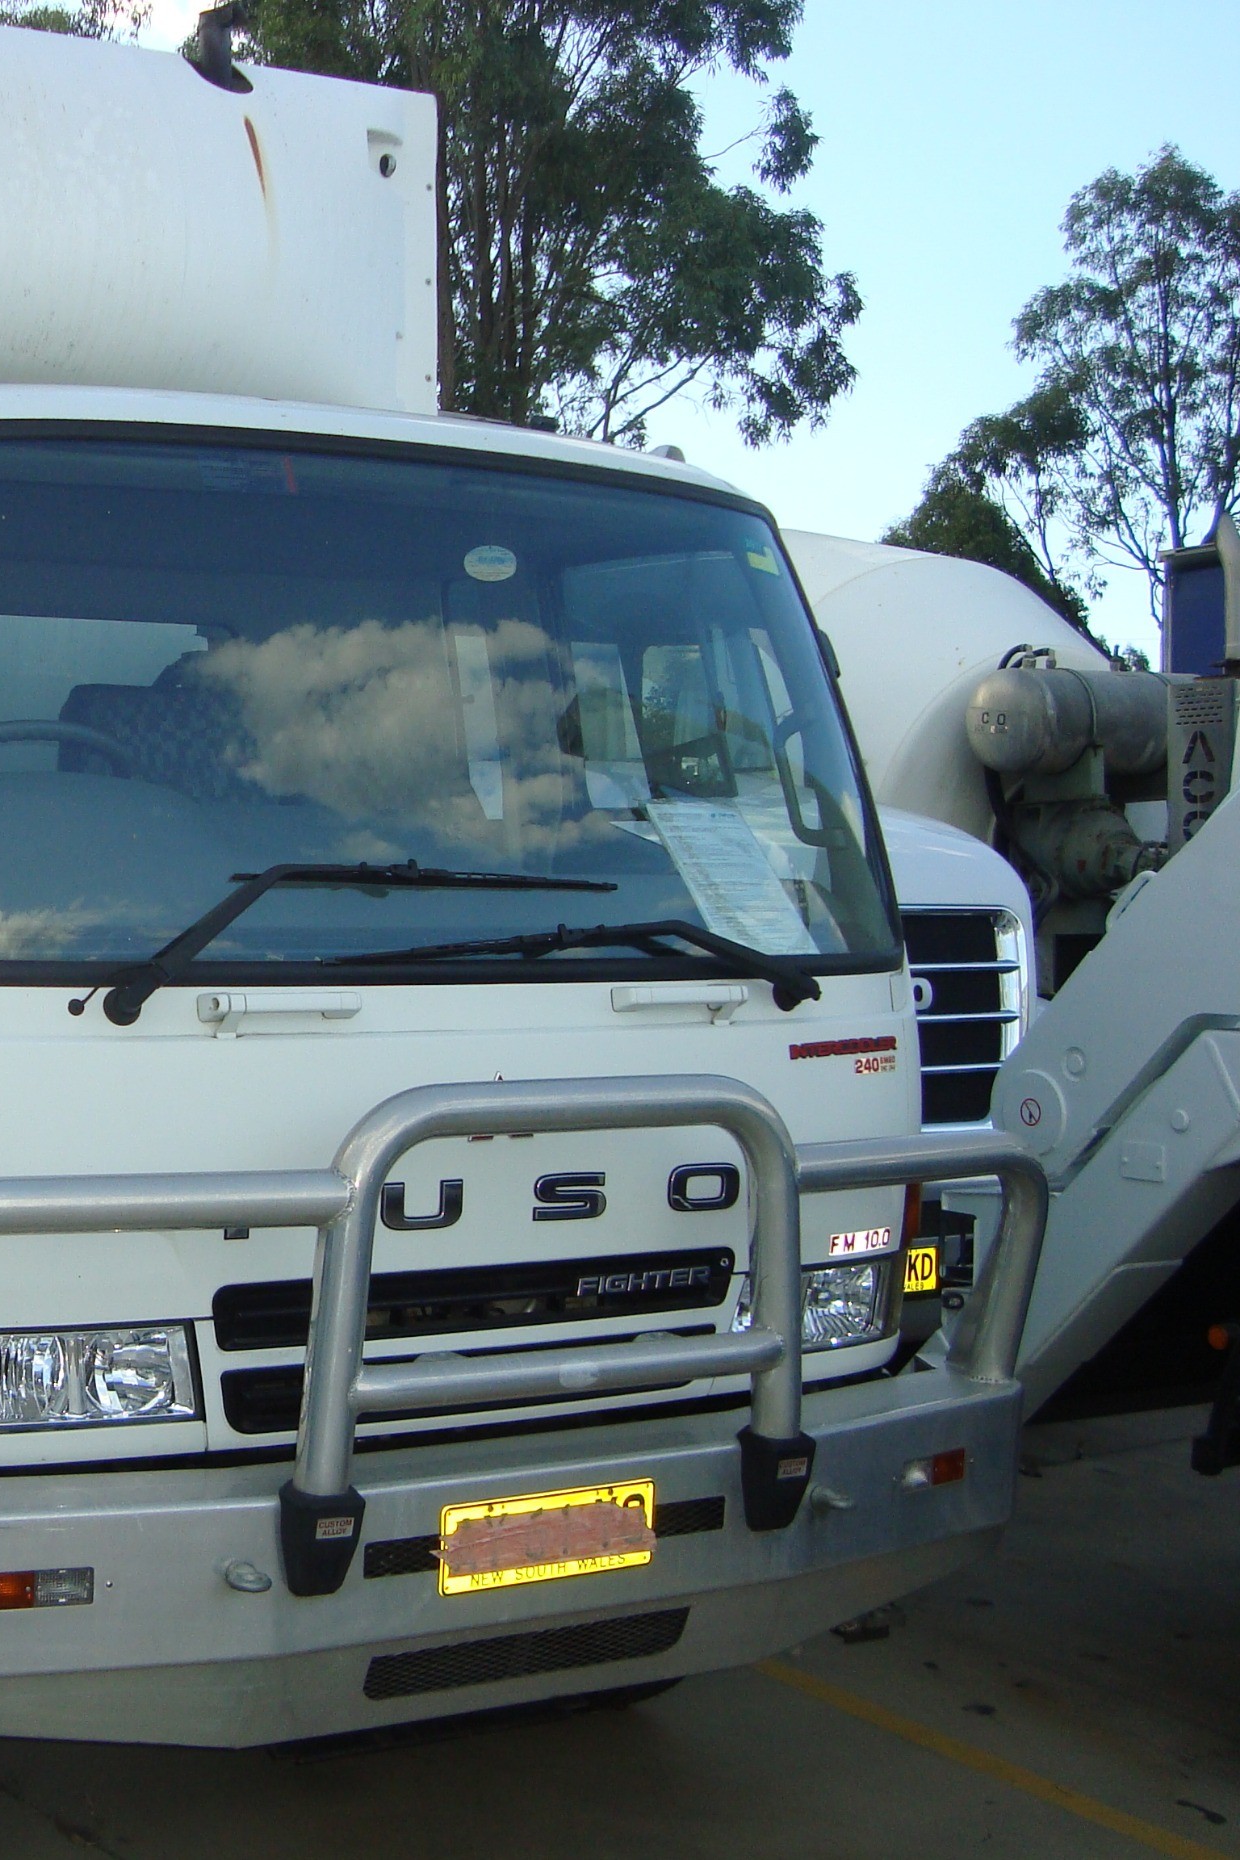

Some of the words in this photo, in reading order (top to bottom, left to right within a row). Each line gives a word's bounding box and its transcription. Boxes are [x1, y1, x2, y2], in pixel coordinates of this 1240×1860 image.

[789, 1035, 897, 1060] INTERCOOLER
[855, 1057, 879, 1074] 240
[829, 1233, 855, 1254] FM
[865, 1228, 891, 1249] 10.0
[576, 1265, 711, 1297] FIGHTER
[904, 1281, 924, 1291] ALES
[318, 1518, 352, 1529] CUSTOM
[322, 1527, 347, 1537] ALLOY
[470, 1572, 503, 1587] NEW
[515, 1562, 566, 1581] SOUTH
[577, 1553, 626, 1571] WALES
